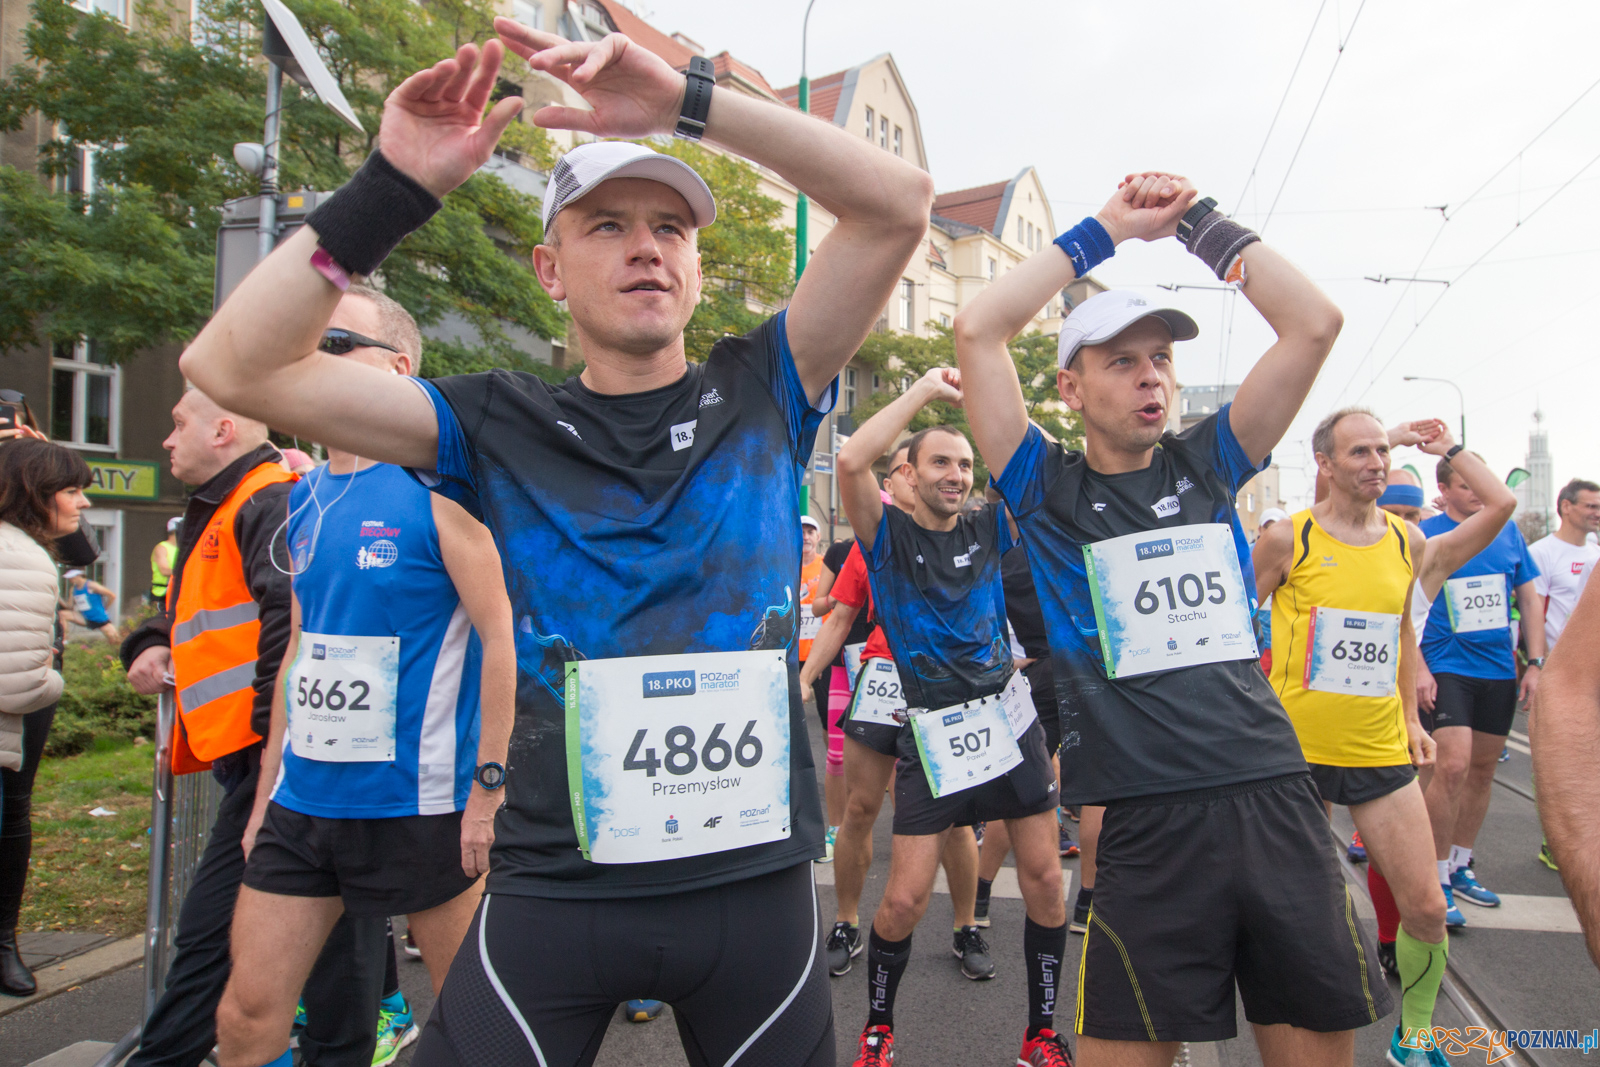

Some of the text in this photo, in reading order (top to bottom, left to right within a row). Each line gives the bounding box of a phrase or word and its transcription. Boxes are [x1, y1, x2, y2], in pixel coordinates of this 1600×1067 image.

[675, 431, 692, 443] 18.
[1139, 543, 1171, 556] 18. PKO
[1176, 543, 1205, 551] maraton
[1133, 570, 1227, 616] 6105
[1463, 593, 1502, 610] 2032
[1167, 610, 1208, 625] Stachu
[1354, 620, 1366, 628] PKO
[1331, 639, 1389, 664] 6386
[1347, 662, 1376, 672] Czesław
[647, 677, 693, 691] 18. PKO
[700, 680, 740, 690] maraton
[297, 676, 370, 712] 5662
[307, 711, 347, 723] Jarosław
[951, 714, 962, 722] PKO
[623, 719, 763, 778] 4866
[948, 726, 991, 758] 507
[652, 775, 742, 797] Przemysław
[703, 815, 723, 829] 4F
[1037, 952, 1059, 1015] Kalenji
